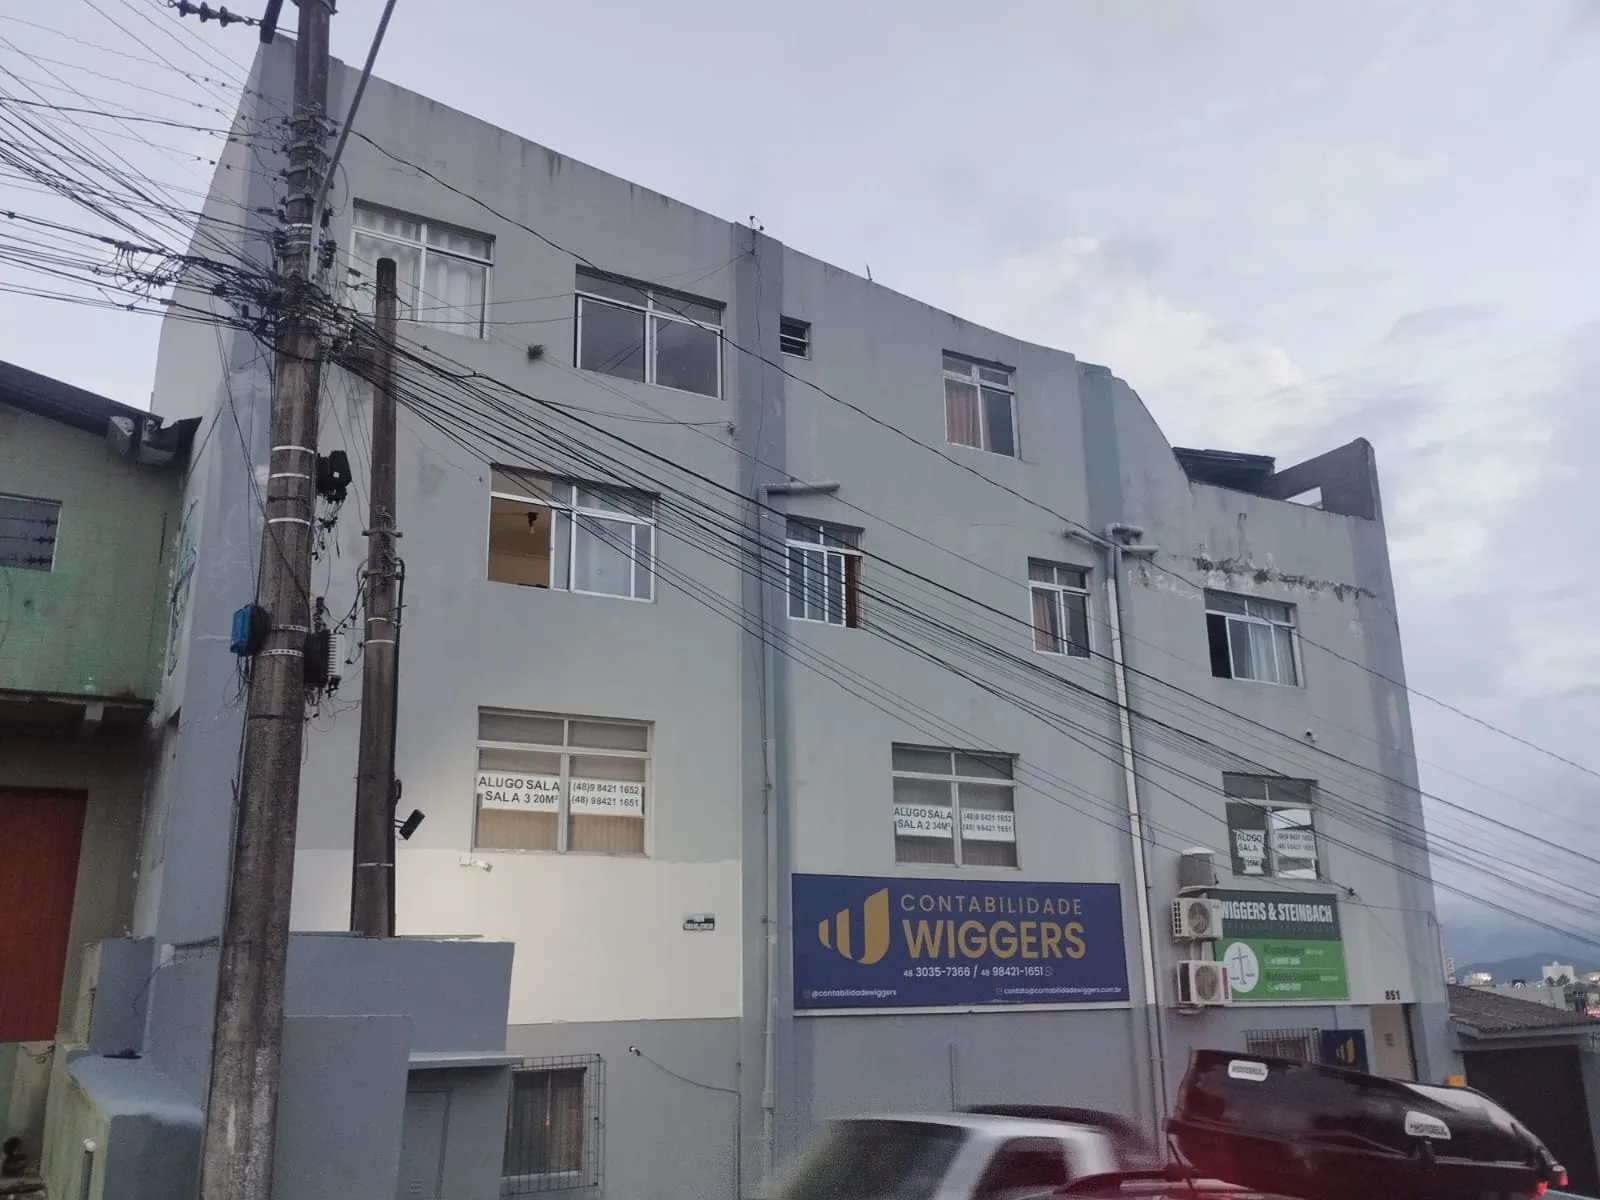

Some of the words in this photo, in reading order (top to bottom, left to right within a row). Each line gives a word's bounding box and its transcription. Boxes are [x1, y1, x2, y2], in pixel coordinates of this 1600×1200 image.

[478, 776, 524, 789] ALUGO
[526, 779, 560, 792] SALA
[596, 783, 617, 793] 8421
[619, 785, 640, 795] 1652
[484, 791, 520, 804] SALA
[524, 793, 531, 804] 3
[571, 795, 589, 806] (48)
[591, 796, 617, 806] 98421
[619, 797, 639, 808] 1651
[894, 807, 926, 818] ALUGO
[928, 809, 952, 820] SALA
[897, 819, 923, 829] SALA
[925, 821, 931, 830] 2
[1239, 843, 1258, 852] SALA
[900, 893, 1082, 915] CONTABILIDADE
[1268, 902, 1278, 921] &
[1278, 903, 1333, 923] STEINBACH
[902, 919, 1086, 959] WIGGERS
[903, 969, 913, 977] 48
[915, 966, 971, 977] 3035-7366
[992, 966, 1044, 977] 98421-1651
[811, 988, 897, 998] @contabilidadewiggers
[1385, 989, 1401, 1001] 851
